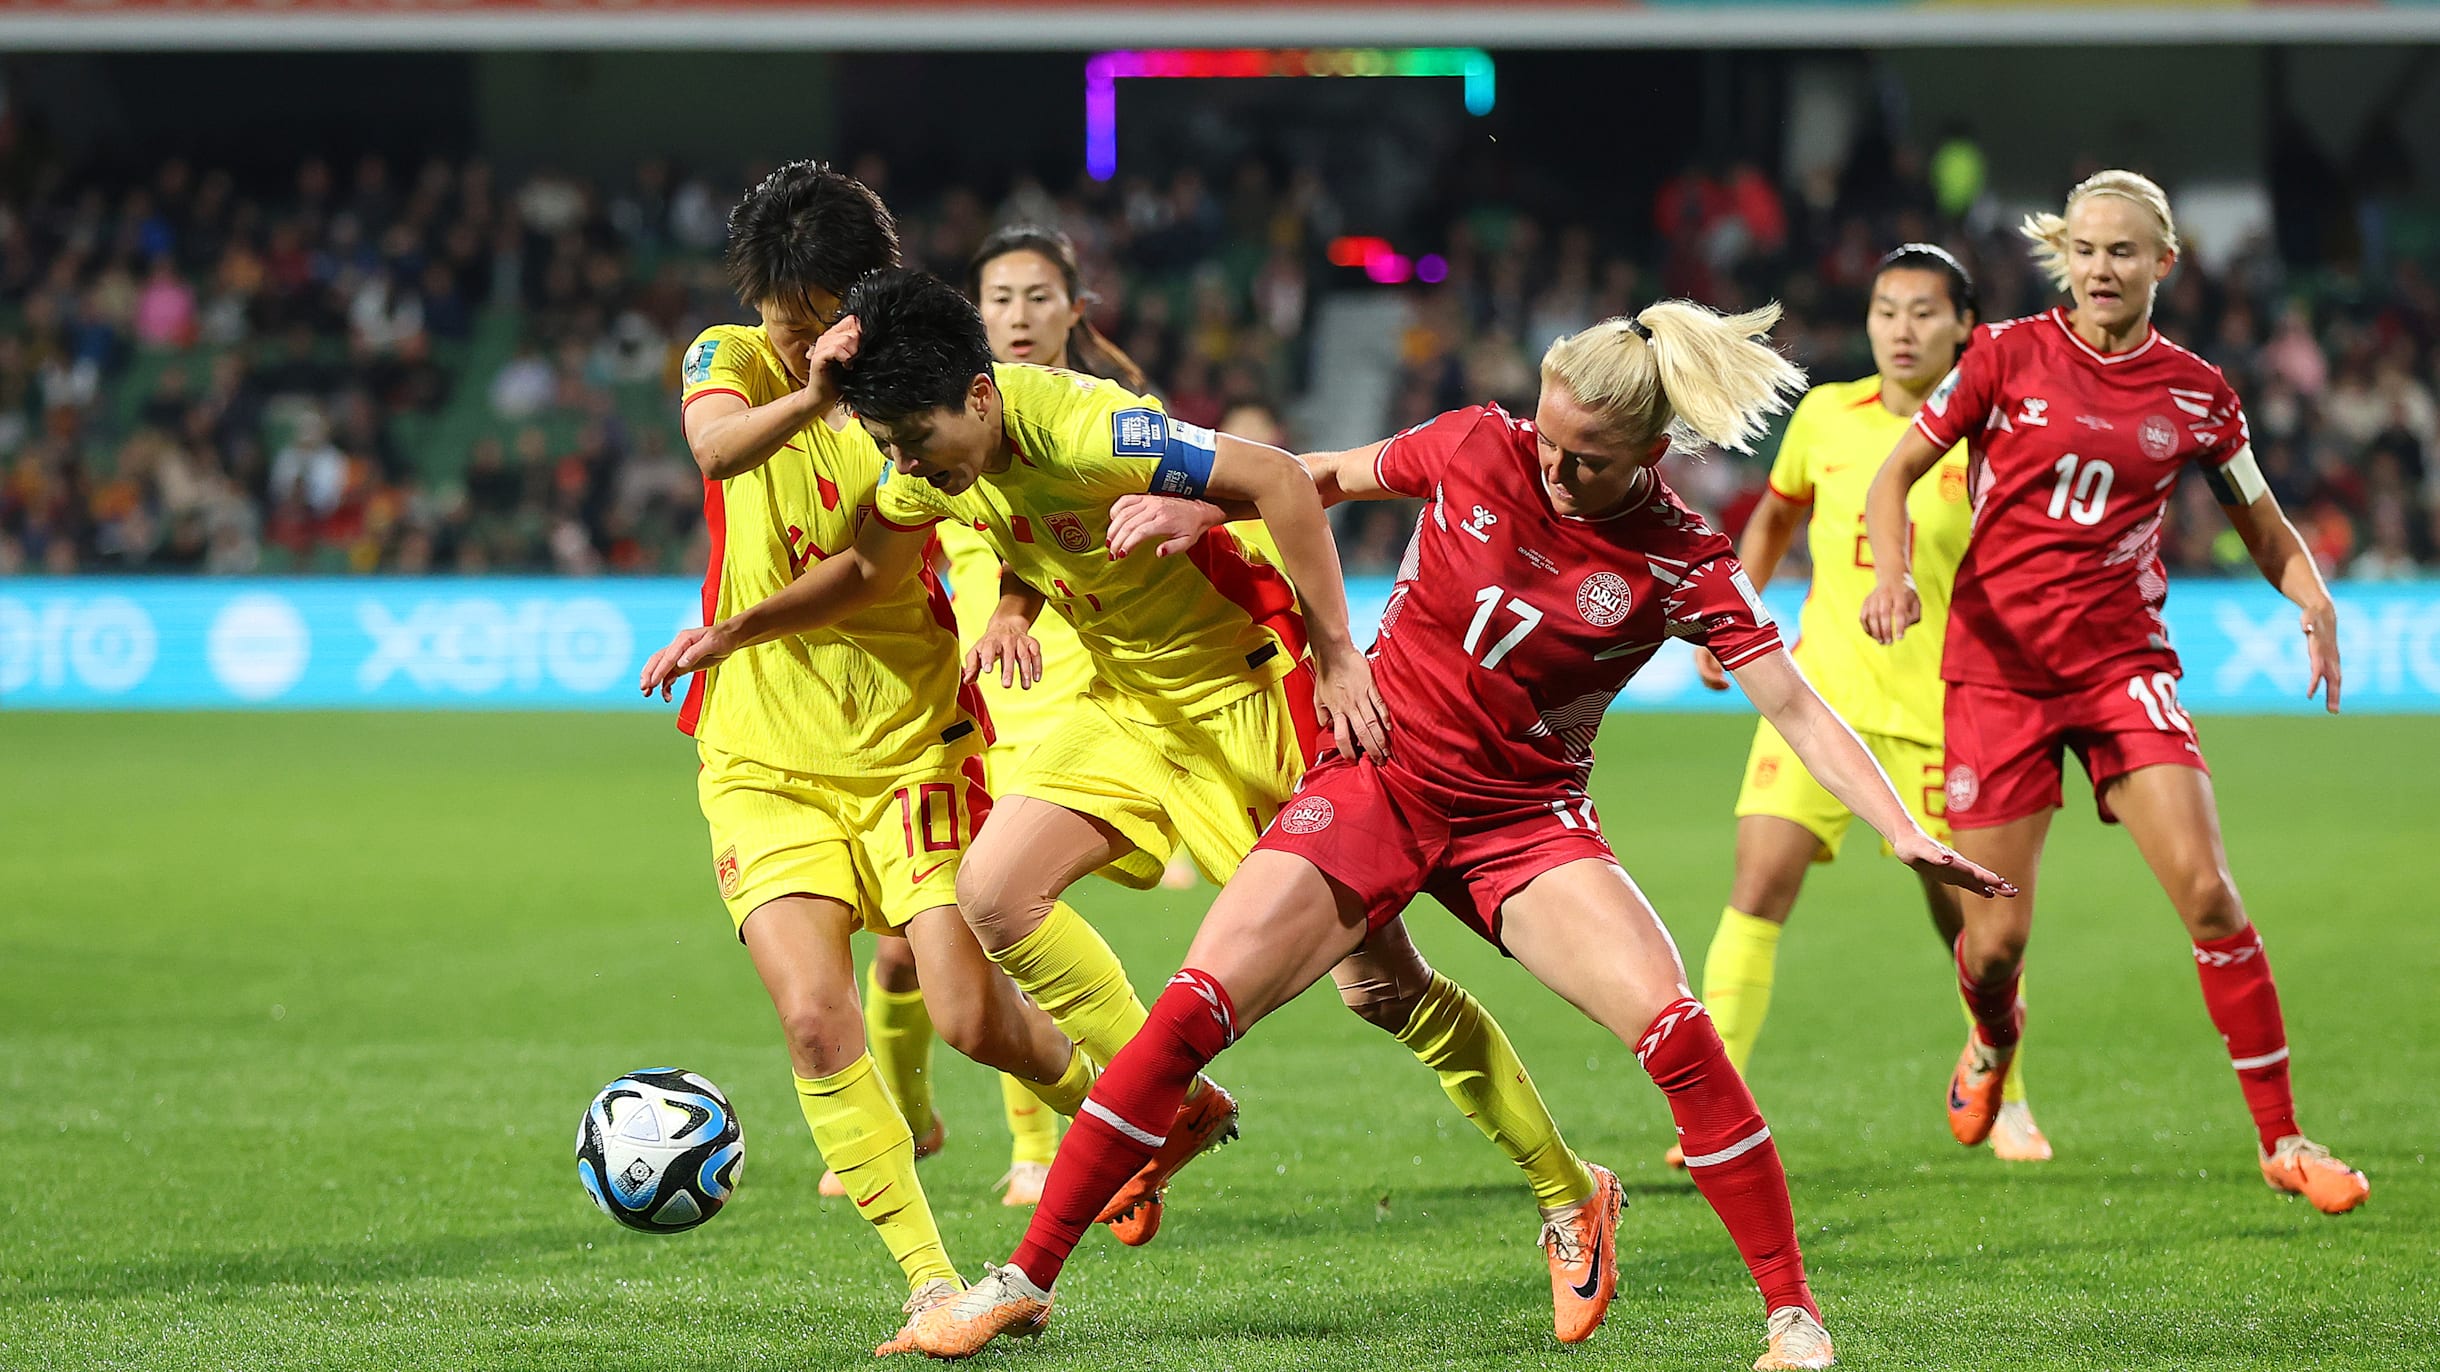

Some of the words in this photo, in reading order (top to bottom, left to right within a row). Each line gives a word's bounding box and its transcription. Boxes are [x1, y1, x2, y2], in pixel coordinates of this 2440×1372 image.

[1130, 416, 1141, 446] UNITES
[2047, 453, 2115, 526] 10
[1463, 585, 1544, 670] 17
[1588, 585, 1621, 613] DBU
[355, 596, 635, 695] xero
[894, 782, 961, 858] 10
[1291, 808, 1324, 822] DBU
